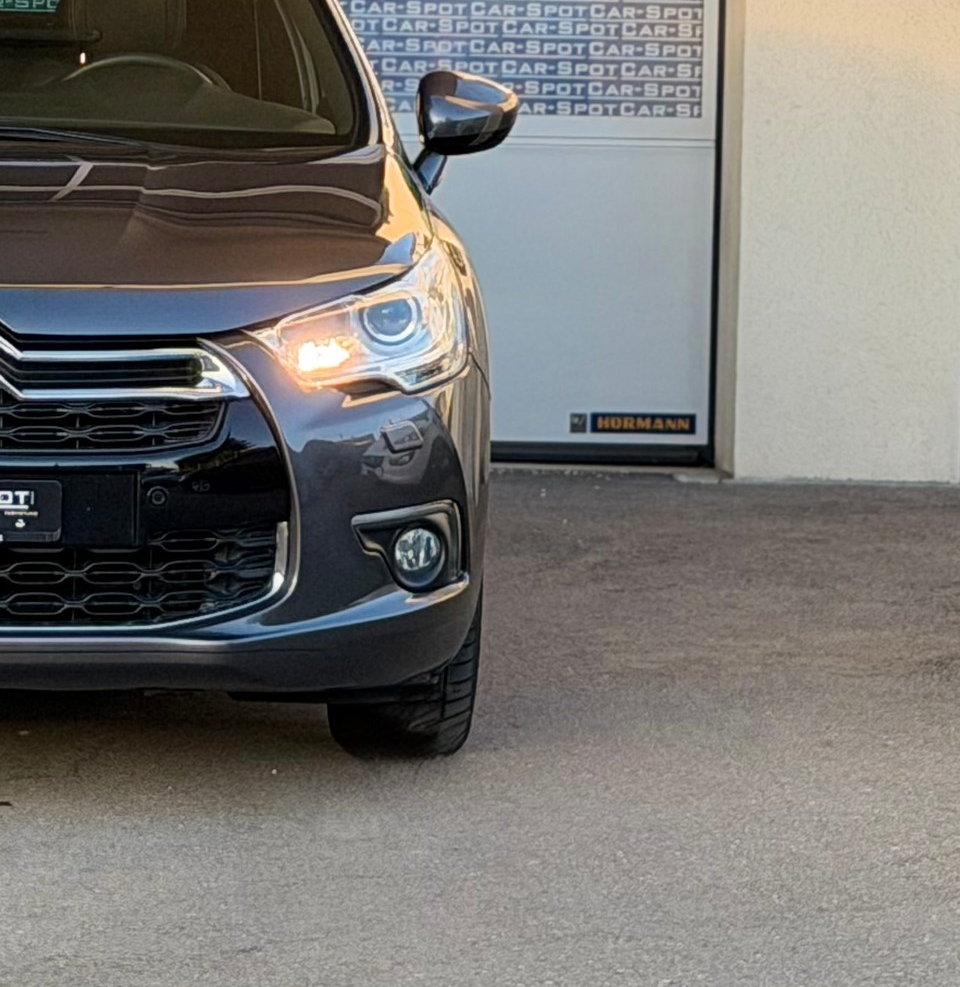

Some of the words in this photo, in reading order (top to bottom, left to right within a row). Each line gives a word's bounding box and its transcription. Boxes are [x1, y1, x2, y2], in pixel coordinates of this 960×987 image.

[350, 0, 468, 16] CAR-SPOT
[470, 2, 588, 18] CAR-SPOT
[382, 18, 500, 34] CAR-SPOT
[502, 21, 620, 37] CAR-SPOT
[469, 40, 587, 56] CAR-SPOT
[501, 61, 619, 77] CAR-SPOT
